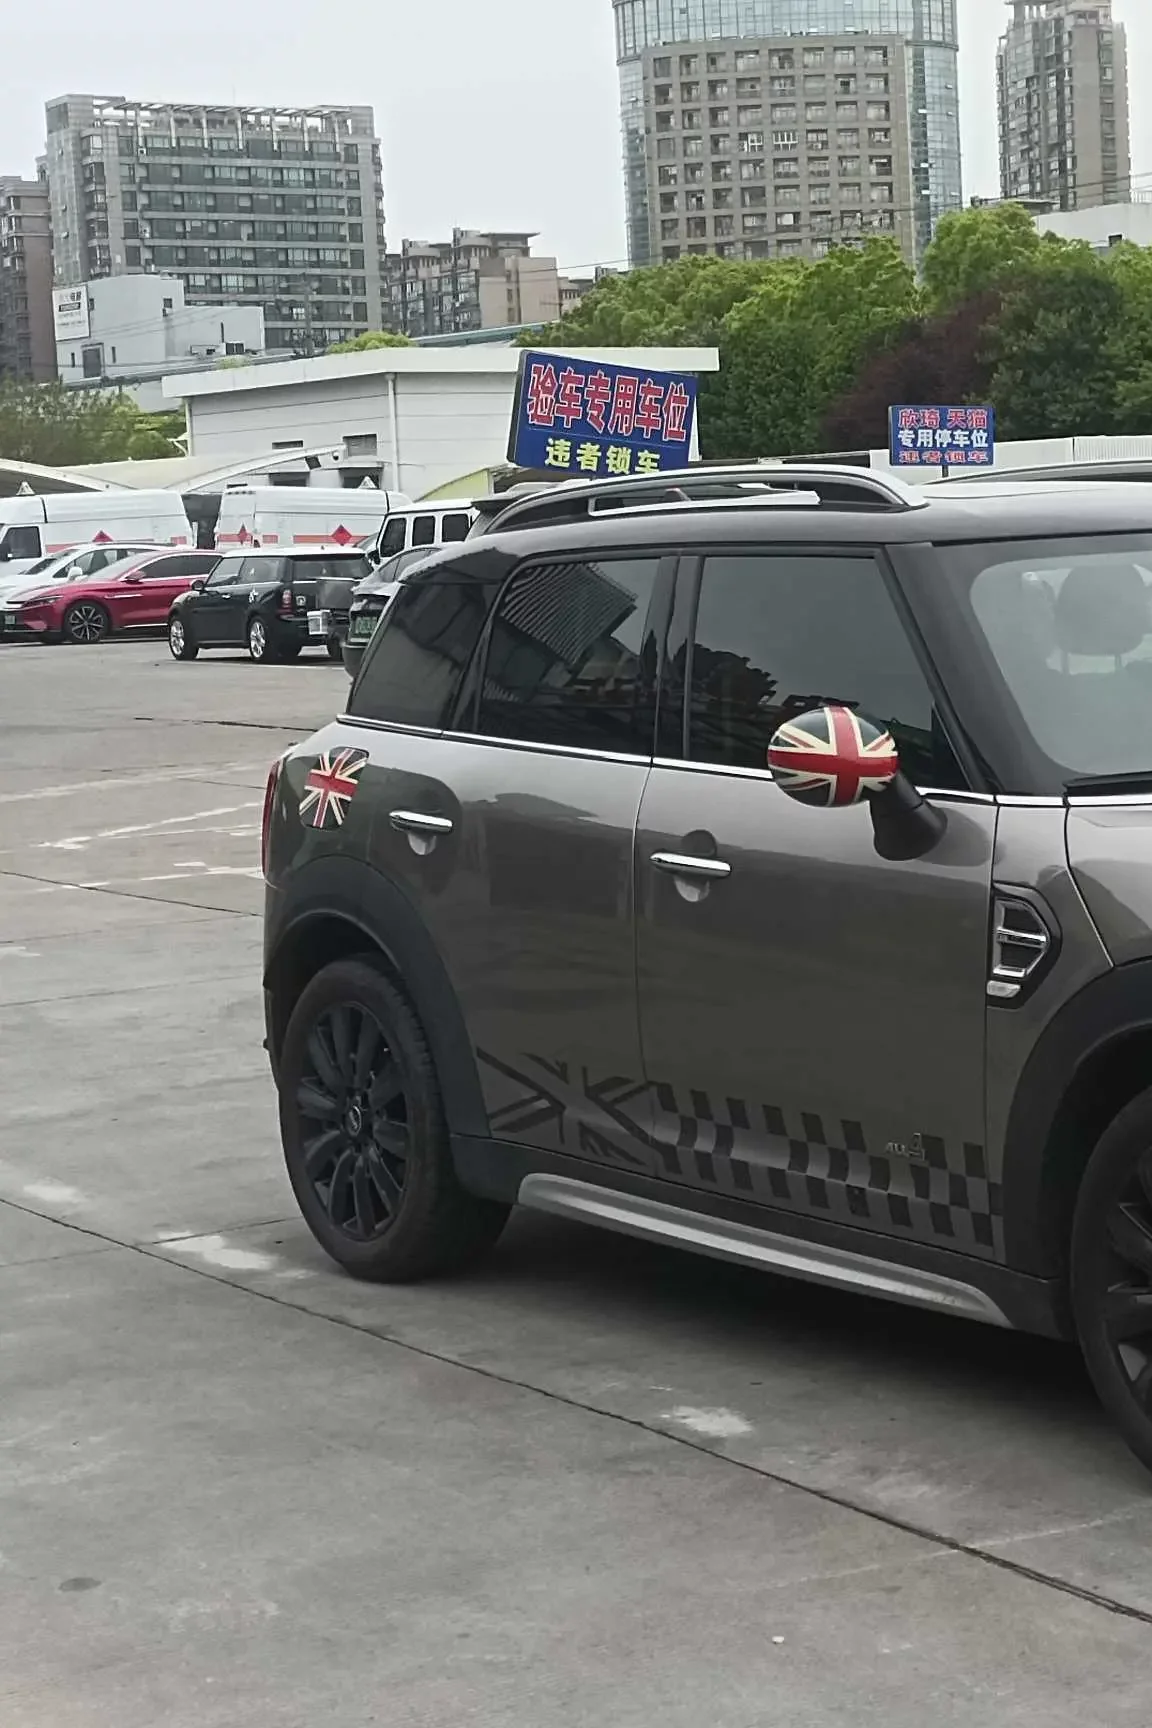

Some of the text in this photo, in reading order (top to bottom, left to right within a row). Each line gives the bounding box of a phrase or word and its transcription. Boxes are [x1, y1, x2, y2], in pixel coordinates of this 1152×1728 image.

[527, 364, 689, 441] 验车专用车位
[899, 408, 988, 429] 欣琦 天猫
[898, 429, 988, 447] 专用停车位
[545, 438, 660, 474] 违者锁车
